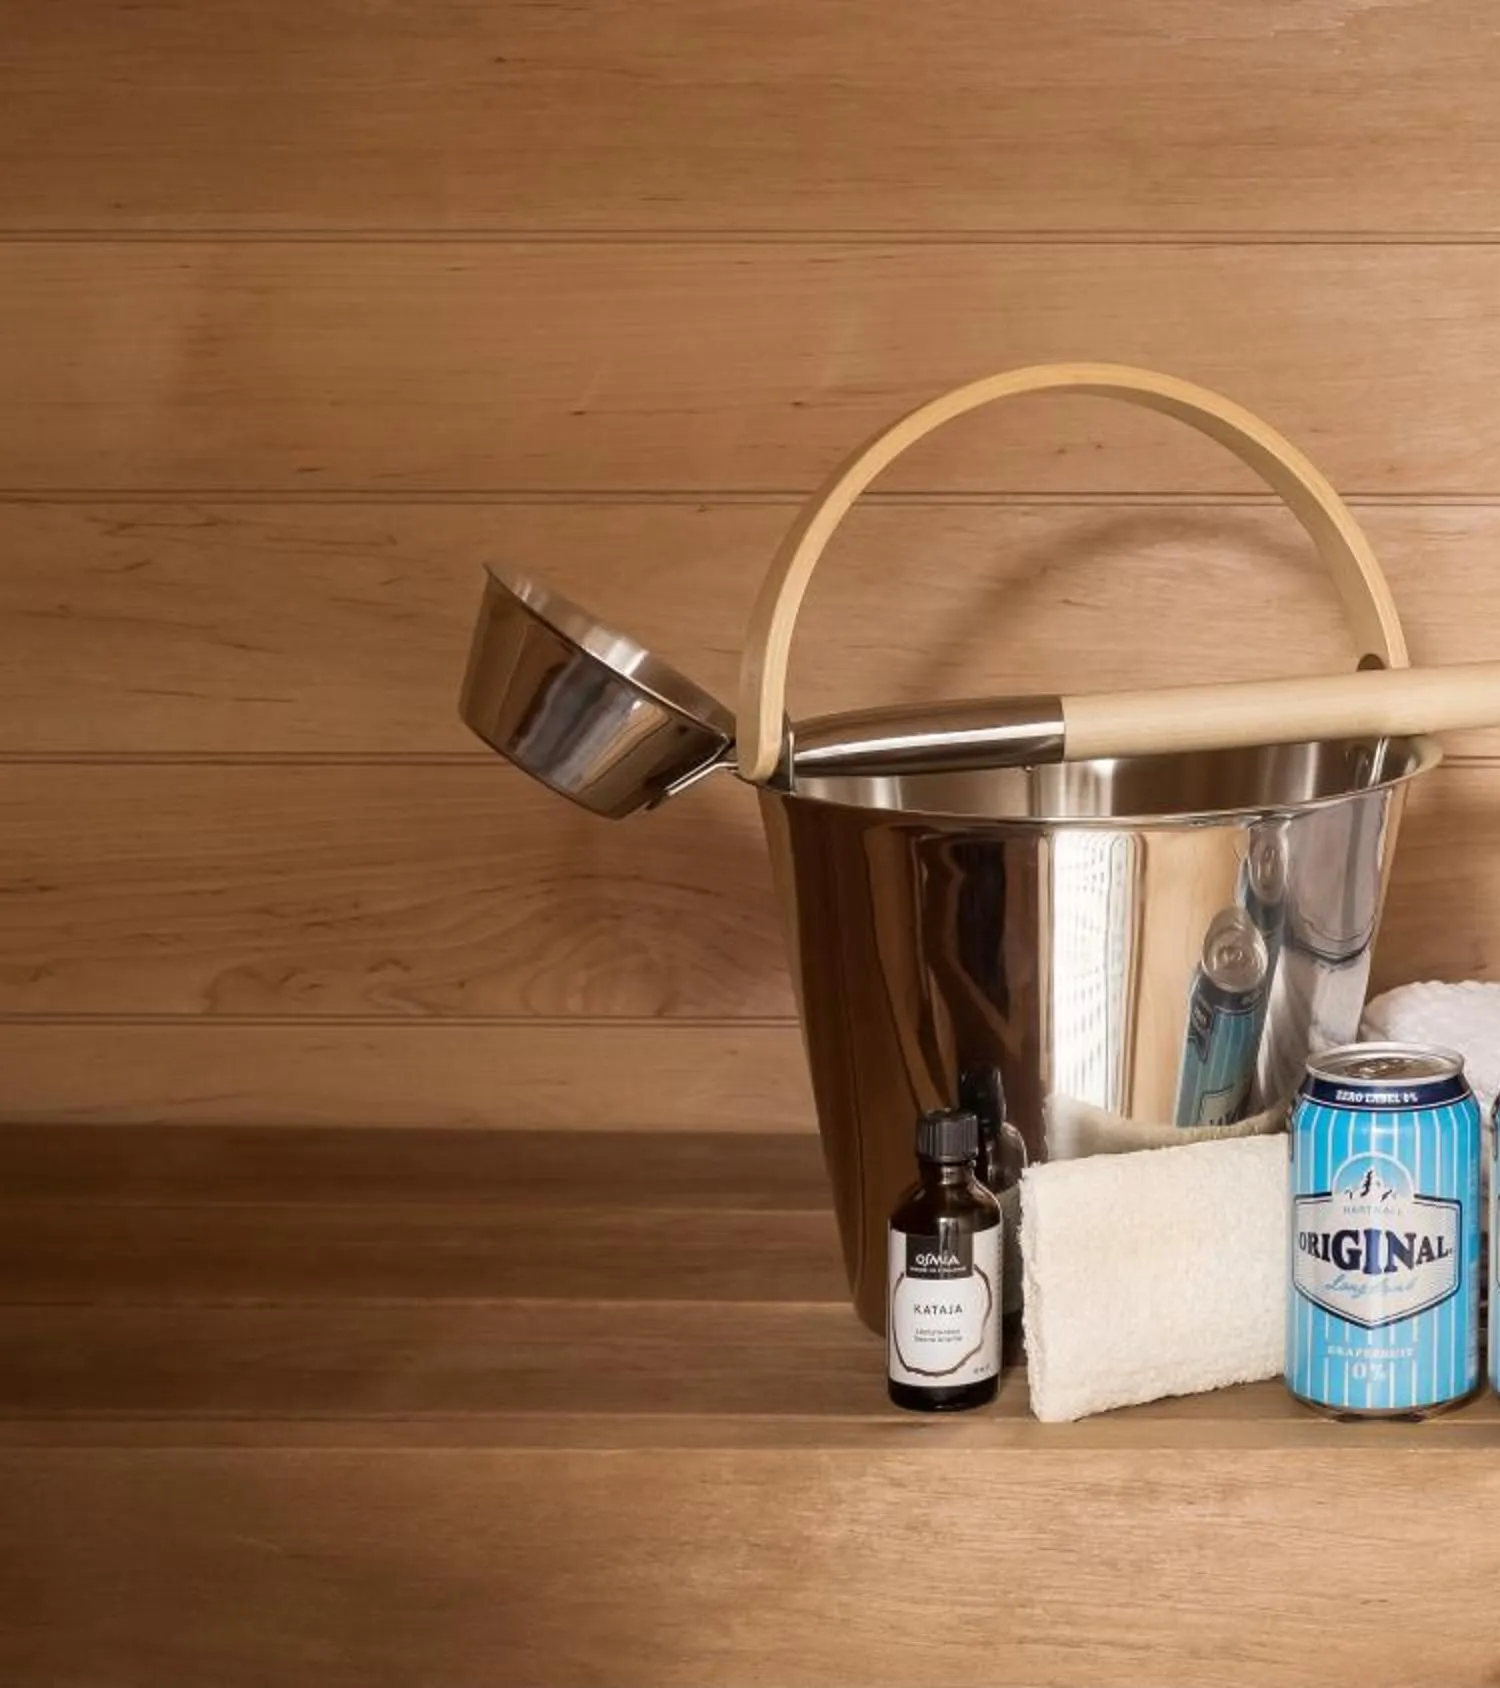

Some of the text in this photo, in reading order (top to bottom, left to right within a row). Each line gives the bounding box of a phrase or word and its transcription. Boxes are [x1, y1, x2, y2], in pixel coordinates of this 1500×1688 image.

[1299, 1229, 1449, 1275] ORIGINAL
[913, 1304, 963, 1315] KATAJA
[1352, 1362, 1387, 1381] 0%
